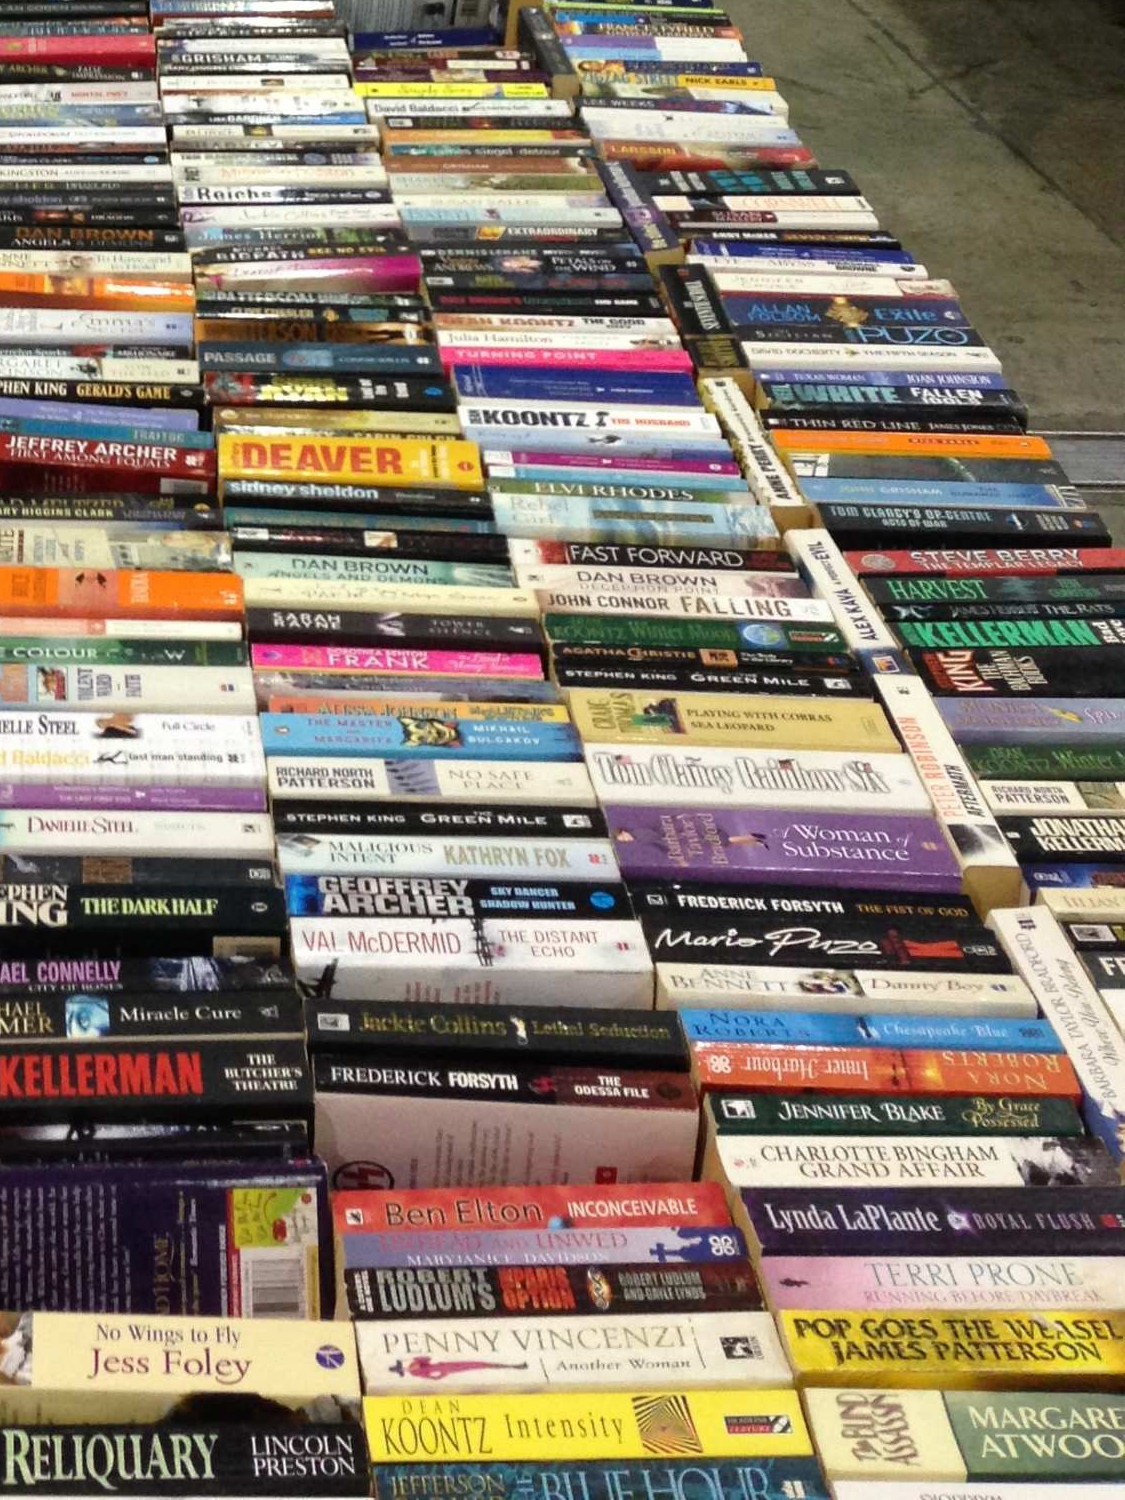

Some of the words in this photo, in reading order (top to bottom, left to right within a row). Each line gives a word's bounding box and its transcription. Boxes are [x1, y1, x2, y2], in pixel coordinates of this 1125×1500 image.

[15, 228, 62, 240] DAN
[70, 229, 155, 241] BROWN
[750, 303, 811, 314] ALLAN
[858, 327, 968, 346] PUZO
[204, 352, 276, 364] PASSAGE
[456, 350, 536, 359] TURNING
[543, 351, 597, 360] POINT
[35, 382, 67, 396] KING
[76, 384, 133, 398] GERALD'S
[136, 386, 171, 399] GAME
[481, 409, 590, 429] KOONTZ
[841, 419, 878, 430] RED
[881, 420, 920, 432] LINE
[5, 436, 91, 454] JEFFREY
[94, 443, 177, 460] ARCHER
[242, 442, 402, 474] DEAVER
[231, 481, 296, 496] sidney
[299, 484, 379, 500] sheldon
[533, 481, 591, 494] ELVI
[596, 484, 694, 500] RHODES
[22, 508, 71, 517] HIGGINS
[74, 508, 113, 517] CLARK
[570, 546, 618, 564] FAST
[627, 548, 744, 567] FORWARD
[994, 549, 1080, 561] BERRY
[292, 558, 338, 571] DAN
[343, 560, 429, 575] BROWN
[577, 571, 624, 585] DAN
[630, 571, 717, 587] BROWN
[887, 580, 988, 601] HARVEST
[547, 594, 594, 608] JOHN
[598, 595, 670, 610] CONNOR
[680, 596, 793, 619] FALLING
[916, 620, 1103, 647] KELLERMAN
[11, 648, 97, 658] COLOUR
[327, 655, 429, 669] FRANK
[565, 669, 637, 679] STEPHEN
[640, 672, 677, 681] KING
[38, 714, 80, 735] STEEL
[276, 766, 329, 778] RICHARD
[332, 768, 374, 779] NORTH
[277, 778, 376, 790] PATTERSON
[996, 794, 1070, 804] PATTERSON
[286, 813, 361, 824] STEPHEN
[366, 815, 406, 824] KING
[793, 824, 890, 844] Woman
[443, 846, 530, 868] KATHRYN
[534, 848, 571, 869] FOX
[782, 839, 910, 861] Substance
[318, 876, 469, 896] GEOFFREY
[80, 898, 122, 915] THE
[122, 898, 171, 915] DARK
[172, 898, 218, 916] HALF
[322, 894, 475, 916] ARCHER
[677, 895, 767, 911] FREDERICK
[771, 897, 845, 914] FORSYTH
[302, 930, 340, 952] VAL
[348, 930, 462, 955] McDERMID
[533, 929, 600, 945] DISTANT
[531, 944, 576, 958] ECHO
[654, 928, 764, 950] Mario
[766, 927, 883, 957] Puzo
[37, 960, 122, 984] CONNELLY
[119, 1007, 190, 1023] Miracle
[195, 1006, 243, 1020] Cure
[358, 1012, 426, 1036] Jackie
[430, 1014, 507, 1037] Collins
[0, 1051, 204, 1098] KELLERMAN
[246, 1053, 275, 1065] THE
[224, 1067, 303, 1080] BUTCHER'S
[330, 1067, 442, 1087] FREDERICK
[448, 1070, 519, 1091] FORSYTH
[597, 1075, 622, 1086] THE
[233, 1079, 298, 1092] THEATRE
[574, 1084, 619, 1097] ODESSA
[623, 1087, 650, 1099] FILE
[777, 1100, 880, 1124] JENNIFER
[880, 1102, 946, 1122] BLAKE
[760, 1145, 891, 1162] CHARLOTTE
[895, 1146, 1000, 1162] BINGHAM
[800, 1161, 891, 1179] GRAND
[898, 1163, 986, 1179] AFFAIR
[385, 1201, 447, 1227] Ben
[455, 1199, 543, 1225] Elton
[567, 1198, 698, 1218] INCONCEIVABLE
[764, 1203, 840, 1232] Lynda
[842, 1205, 942, 1232] LaPlante
[864, 1261, 959, 1287] TERRI
[971, 1261, 1085, 1287] PRONE
[379, 1284, 497, 1312] LUDLUM'S
[95, 1323, 122, 1341] No
[129, 1323, 184, 1345] Wings
[190, 1326, 210, 1342] to
[215, 1326, 242, 1346] Fly
[383, 1330, 502, 1354] PENNY
[511, 1326, 688, 1352] VINCENZI
[794, 1318, 850, 1338] POP
[861, 1319, 939, 1340] GOES
[945, 1319, 999, 1339] THE
[1003, 1319, 1124, 1342] WEASEL
[833, 1342, 929, 1364] JAMES
[936, 1342, 1103, 1362] PATTERSON
[88, 1349, 151, 1379] Jess
[161, 1348, 254, 1385] Foley
[556, 1359, 622, 1372] Another
[628, 1358, 691, 1370] Woman
[402, 1399, 462, 1415] DEAN
[381, 1417, 493, 1456] KOONTZ
[504, 1413, 624, 1446] Intensity
[3, 1429, 220, 1494] RELIQUARY
[250, 1434, 355, 1458] LINCOLN
[252, 1457, 357, 1479] PRESTON
